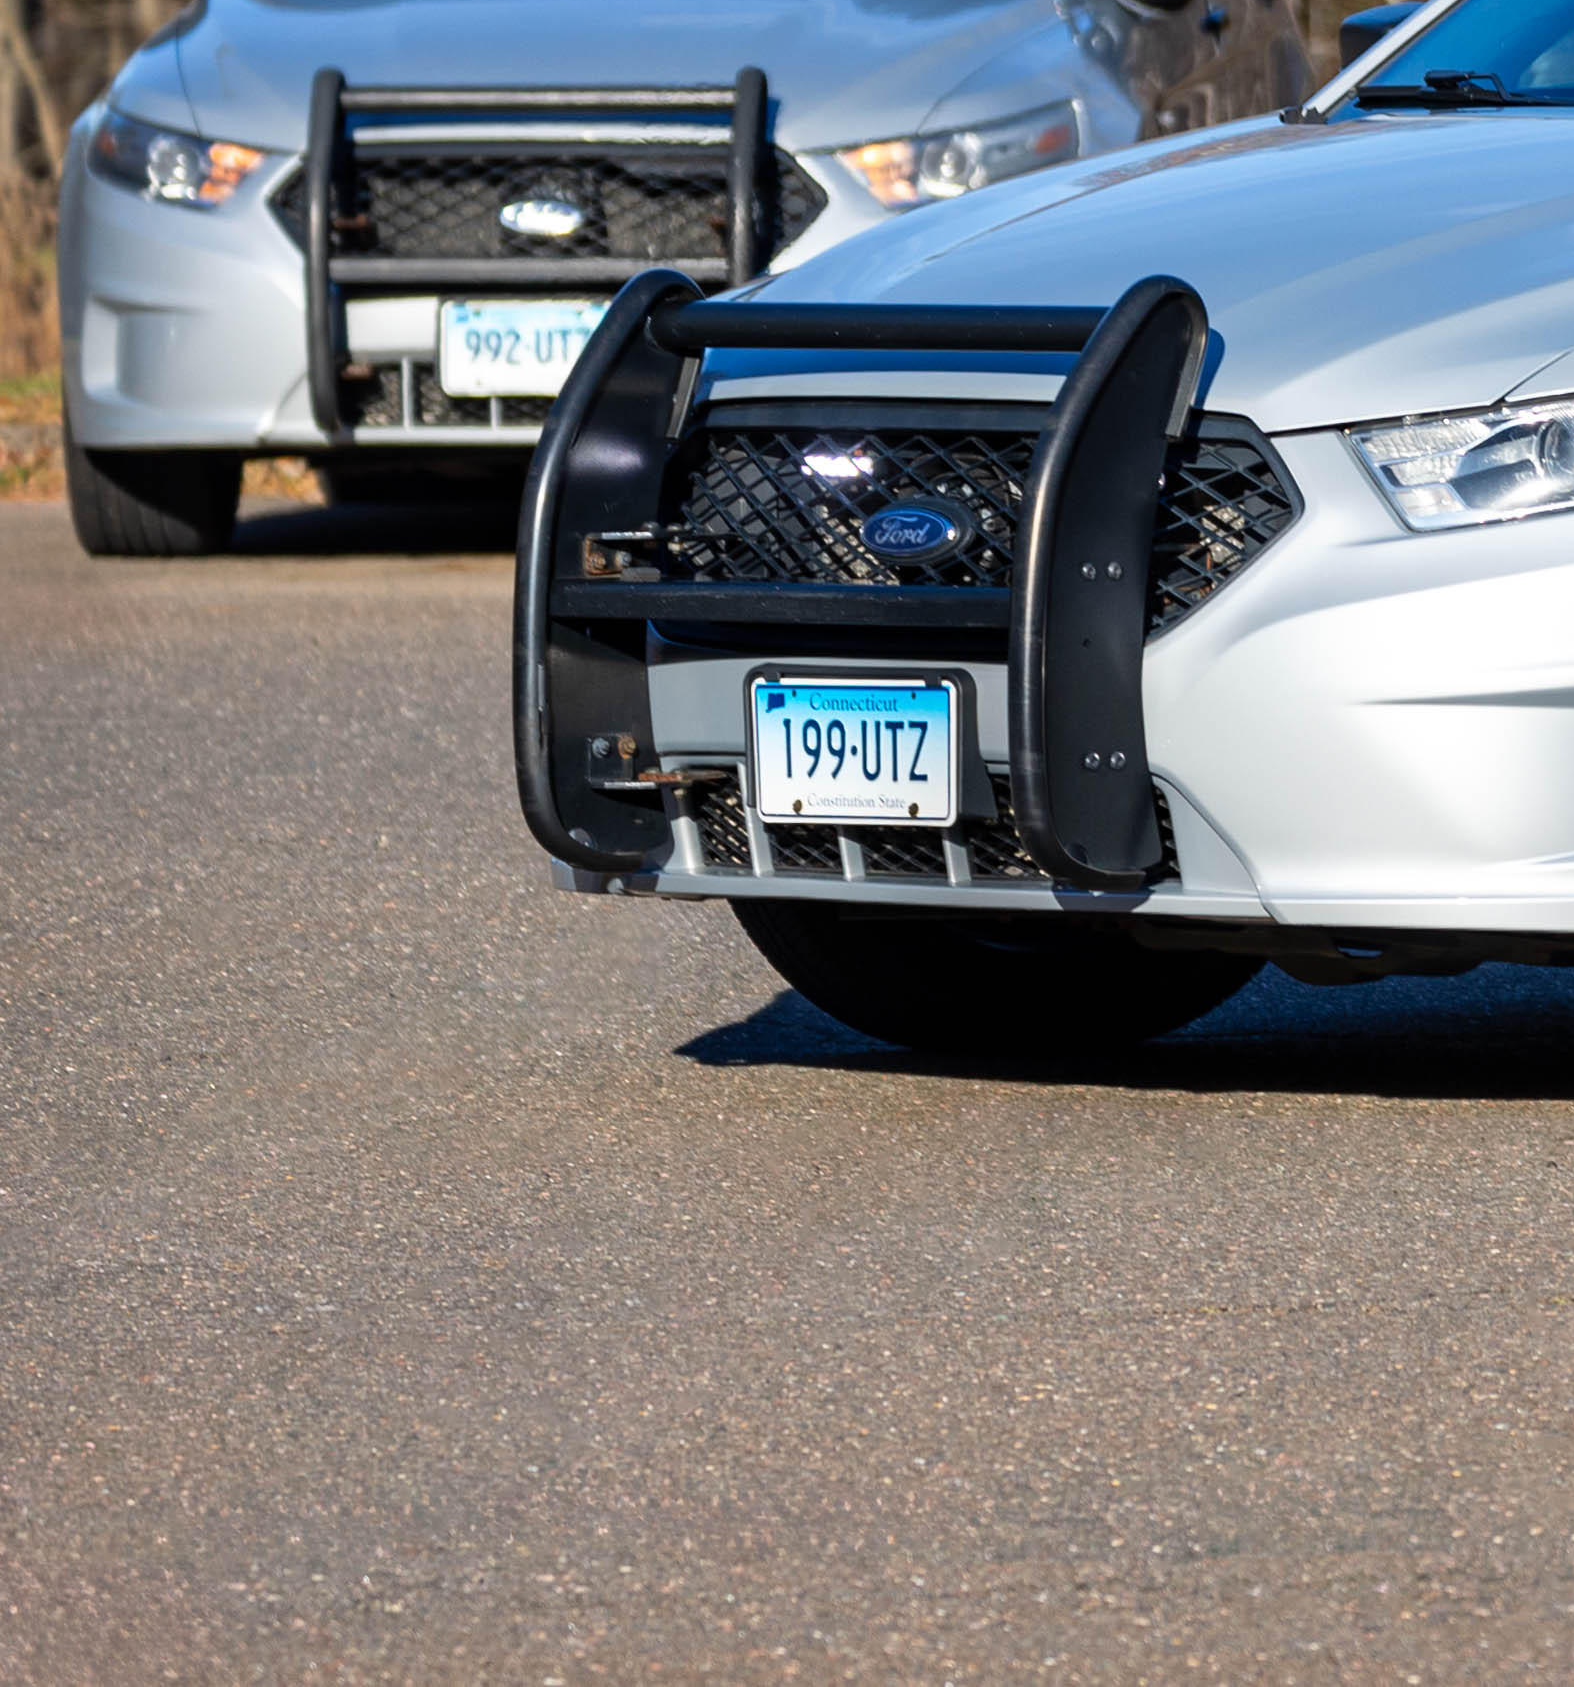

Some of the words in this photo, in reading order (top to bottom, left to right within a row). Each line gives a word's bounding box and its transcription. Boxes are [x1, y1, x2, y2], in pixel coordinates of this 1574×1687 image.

[875, 515, 931, 545] Ford
[809, 693, 898, 712] Connecticut
[807, 794, 876, 809] Constitution
[879, 794, 906, 809] State
